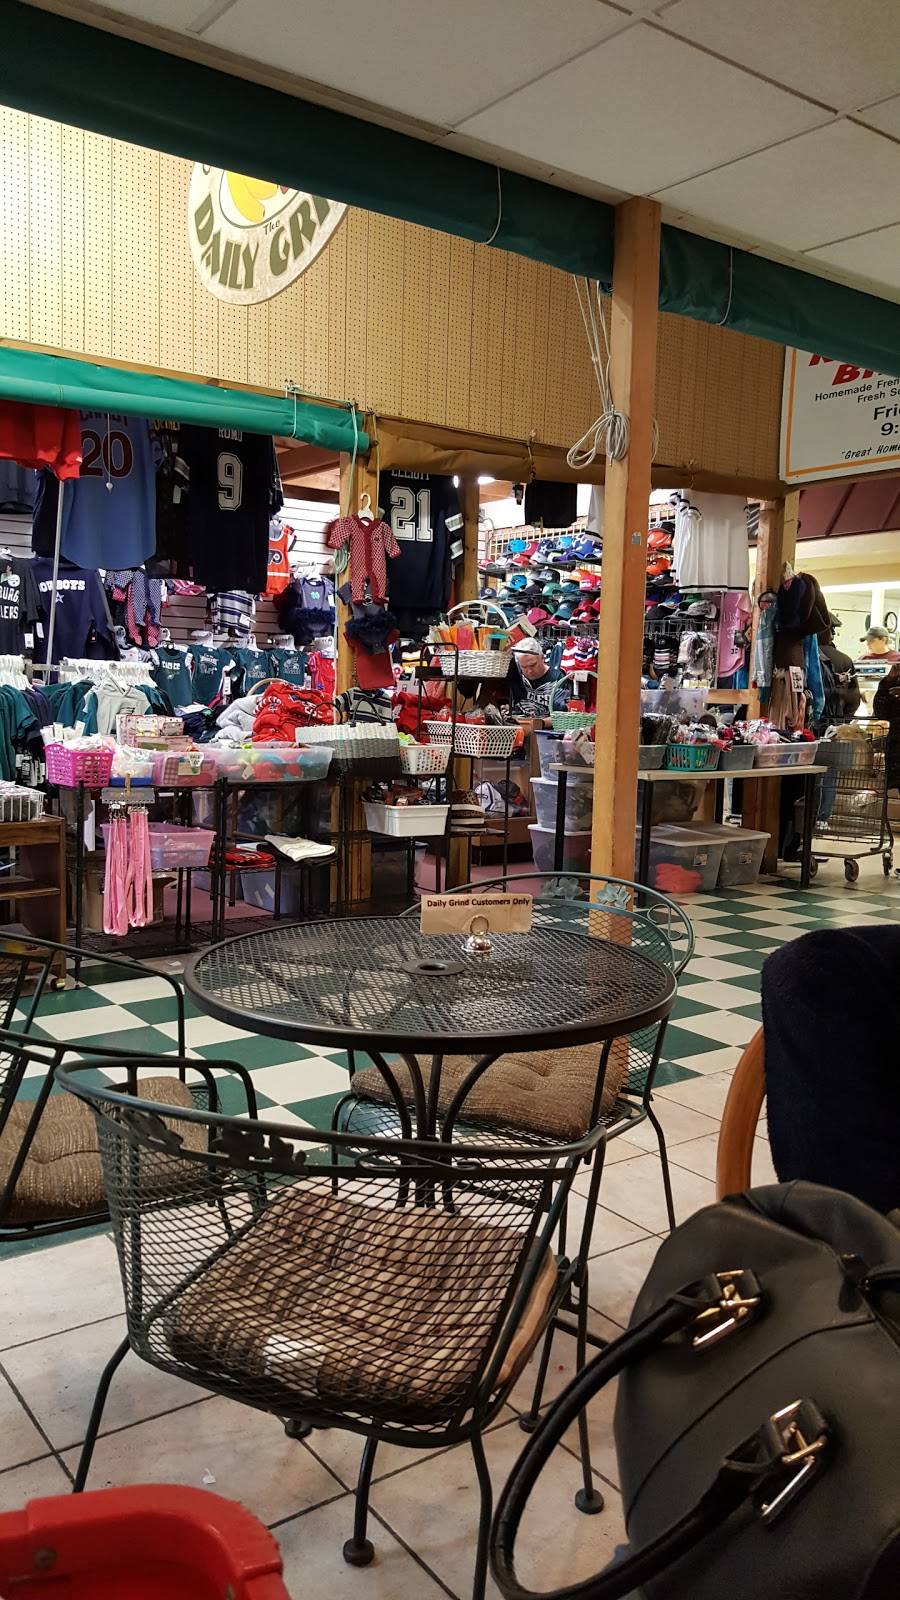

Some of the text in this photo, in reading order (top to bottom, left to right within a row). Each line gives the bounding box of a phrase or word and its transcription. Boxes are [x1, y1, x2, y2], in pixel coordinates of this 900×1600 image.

[263, 219, 281, 236] The
[195, 193, 260, 290] DAILY
[814, 384, 873, 402] Homemade
[857, 392, 886, 404] Fresh
[873, 403, 900, 421] Fri
[79, 430, 134, 479] 20
[216, 451, 244, 512] 9
[389, 485, 434, 543] 21
[427, 897, 530, 909] Daily Grind Customers Only
